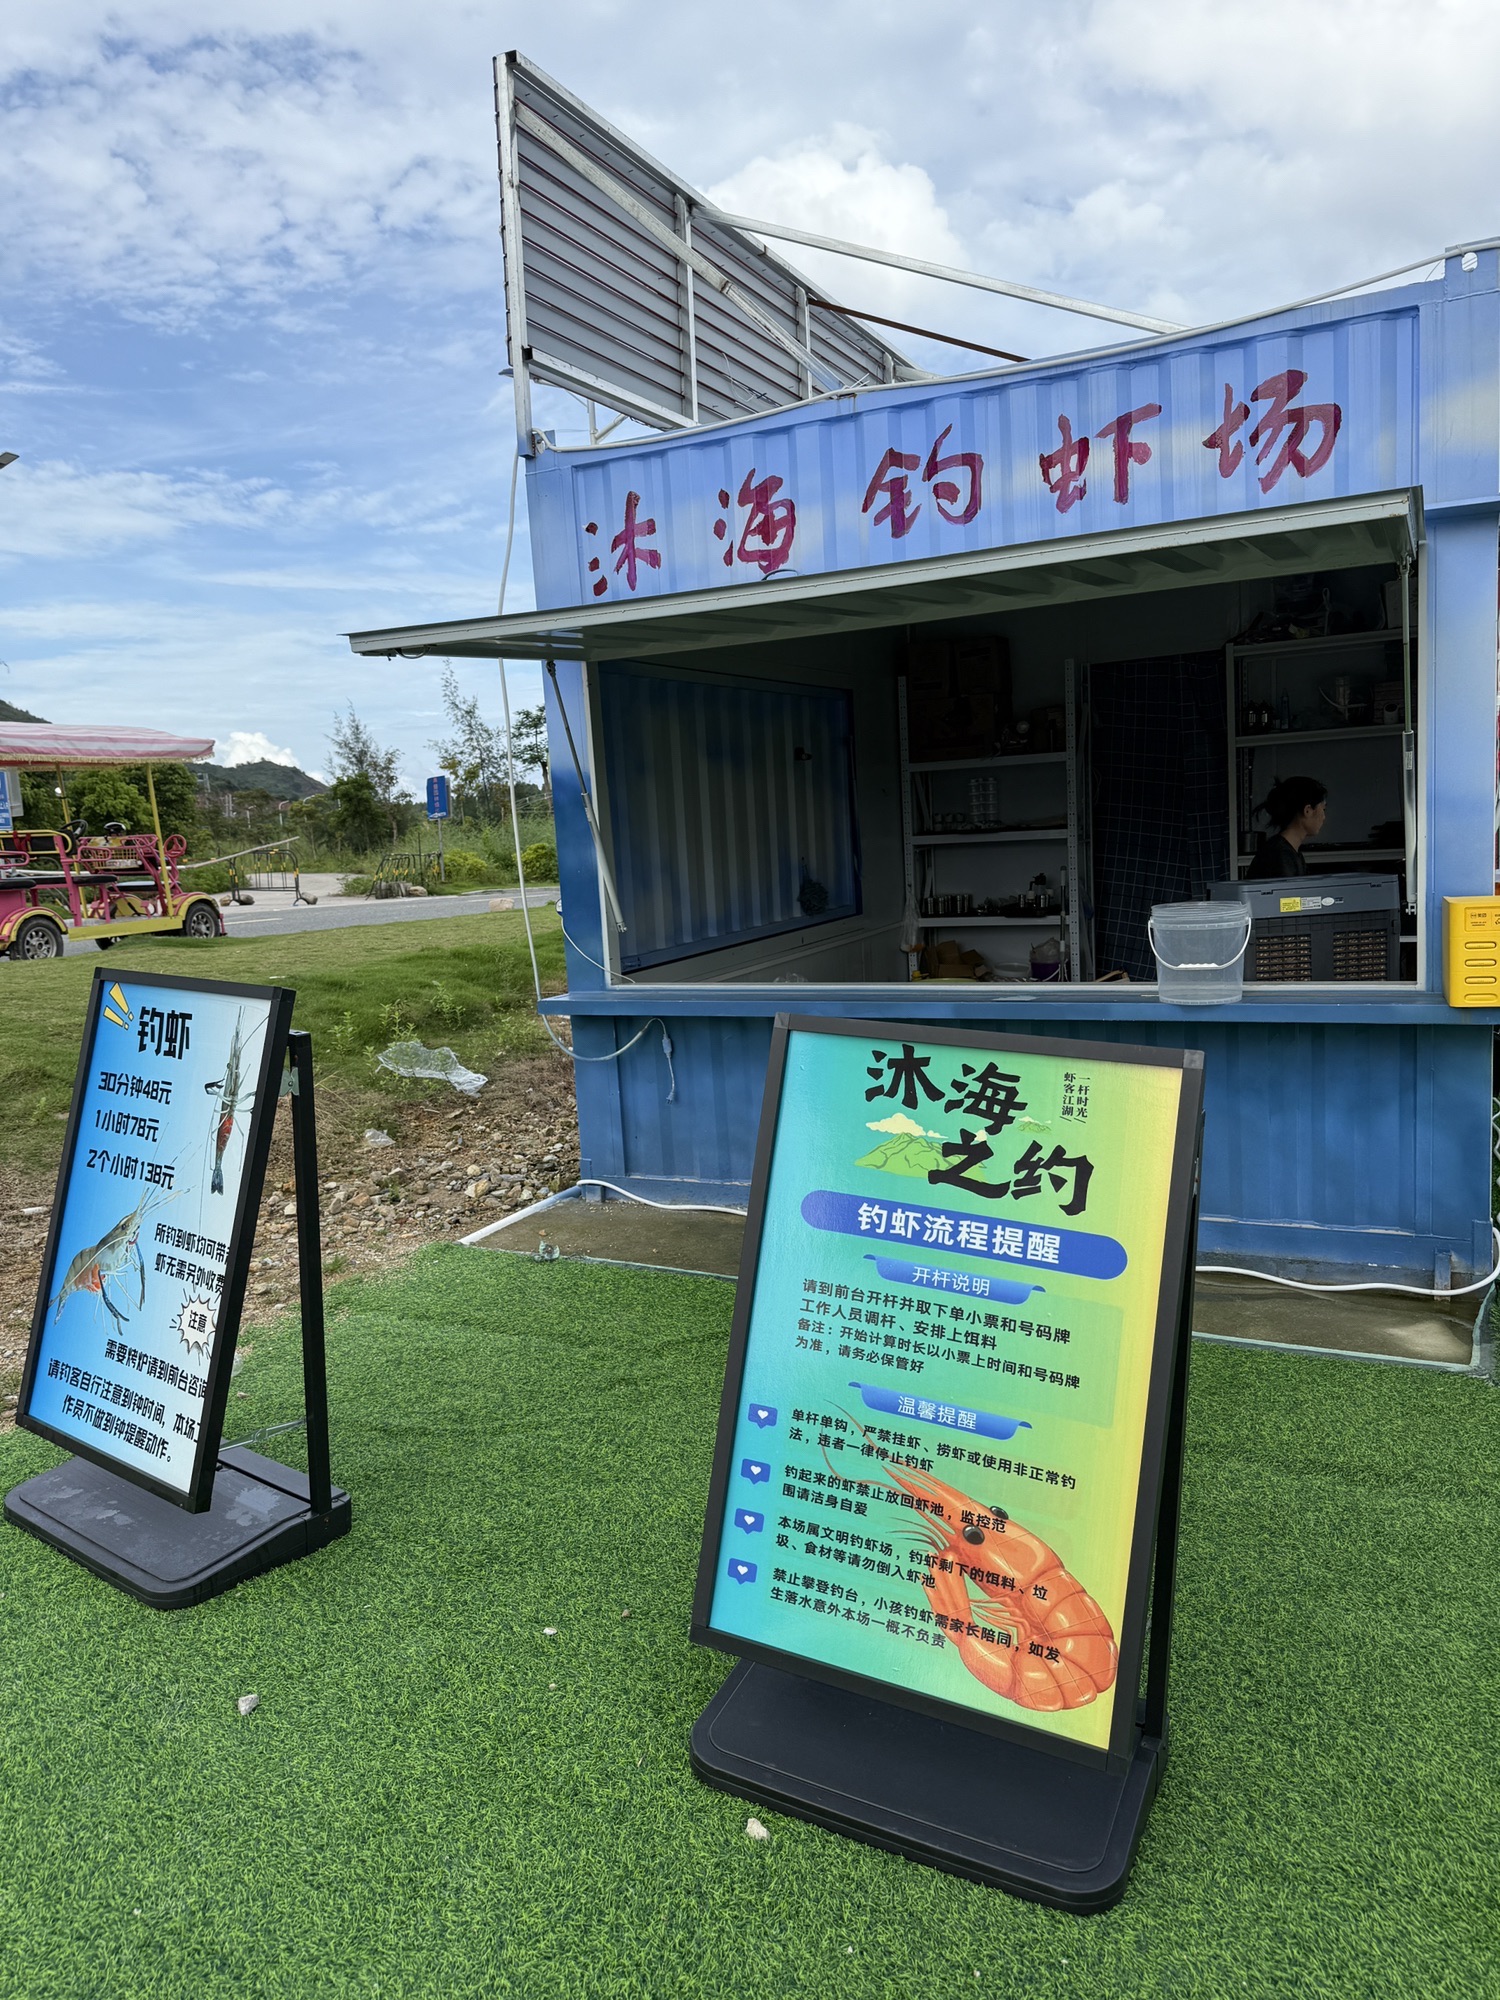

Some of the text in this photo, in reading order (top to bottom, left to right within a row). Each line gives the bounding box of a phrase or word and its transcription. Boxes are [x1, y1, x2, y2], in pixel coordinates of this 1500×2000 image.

[584, 370, 1341, 596] 沐海钓虾场
[137, 1006, 192, 1060] 钓虾
[98, 1071, 172, 1105] 30分钟48元
[864, 1043, 1028, 1135] 沐海
[1062, 1072, 1076, 1117] 虾客江湖
[1076, 1077, 1091, 1118] 一杆时光
[95, 1109, 159, 1142] 1小时78元
[86, 1149, 175, 1190] 2个小时138元
[927, 1129, 1094, 1216] 之约
[857, 1203, 1061, 1265] 钓虾流程提醒
[912, 1266, 990, 1296] 开杆说明
[188, 1310, 208, 1333] 注意
[799, 1298, 997, 1350] 工作人员调杆、安排上饵料
[802, 1278, 1071, 1344] 请到前台开杆并取下单小票和号码牌
[795, 1335, 924, 1374] 为准，请务必保管好
[797, 1317, 1080, 1389] 备注：开始计算时长以小票上时间和号码牌
[61, 1394, 172, 1462] 作员不做到钟提醒动作。
[898, 1396, 977, 1430] 温馨提醒
[789, 1427, 934, 1473] 法，违者一律停止钓虾
[791, 1409, 1076, 1489] 单杆单钩，严禁挂虾、捞虾或使用非正常钓
[782, 1483, 868, 1517] 围请洁身自爱
[784, 1465, 1007, 1534] 钓起来的虾禁止放回虾池，监控范
[775, 1534, 936, 1588] 圾、食材等请勿倒入虾池
[777, 1515, 1048, 1601] 本场属文明钓虾场，钓虾剩下的饵料、垃
[770, 1586, 946, 1649] 生落水意外本场一概不负责
[772, 1567, 1060, 1663] 禁止攀登钓台，小孩钓虾需家长陪同，如发
